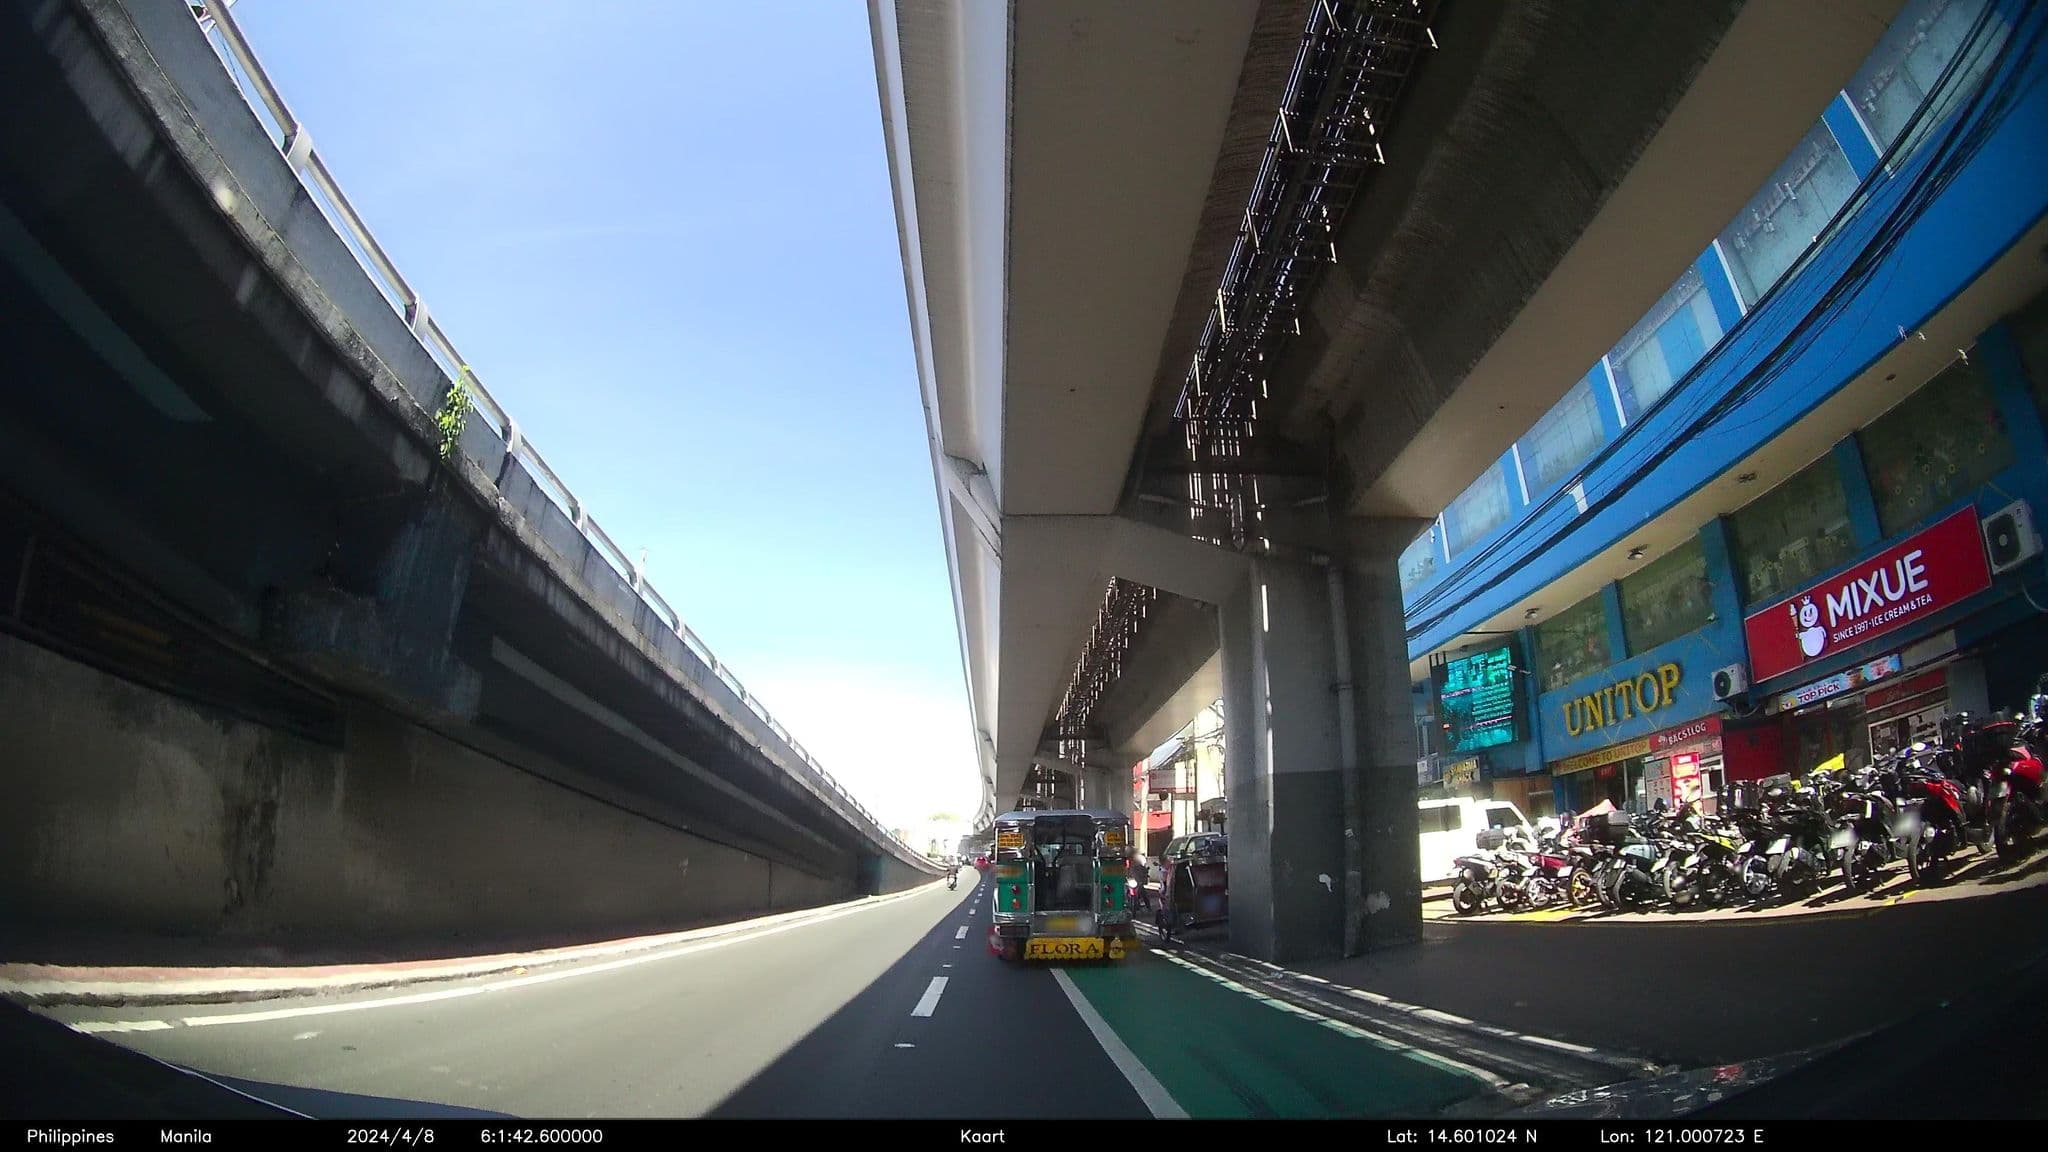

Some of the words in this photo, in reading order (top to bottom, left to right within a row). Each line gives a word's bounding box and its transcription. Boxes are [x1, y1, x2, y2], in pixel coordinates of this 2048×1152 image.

[1826, 549, 1929, 628] MIXUE
[1833, 627, 1855, 643] SINCE
[1562, 663, 1681, 737] UNITOP
[1797, 691, 1817, 703] TOP
[1668, 722, 1707, 745] BACSILOG
